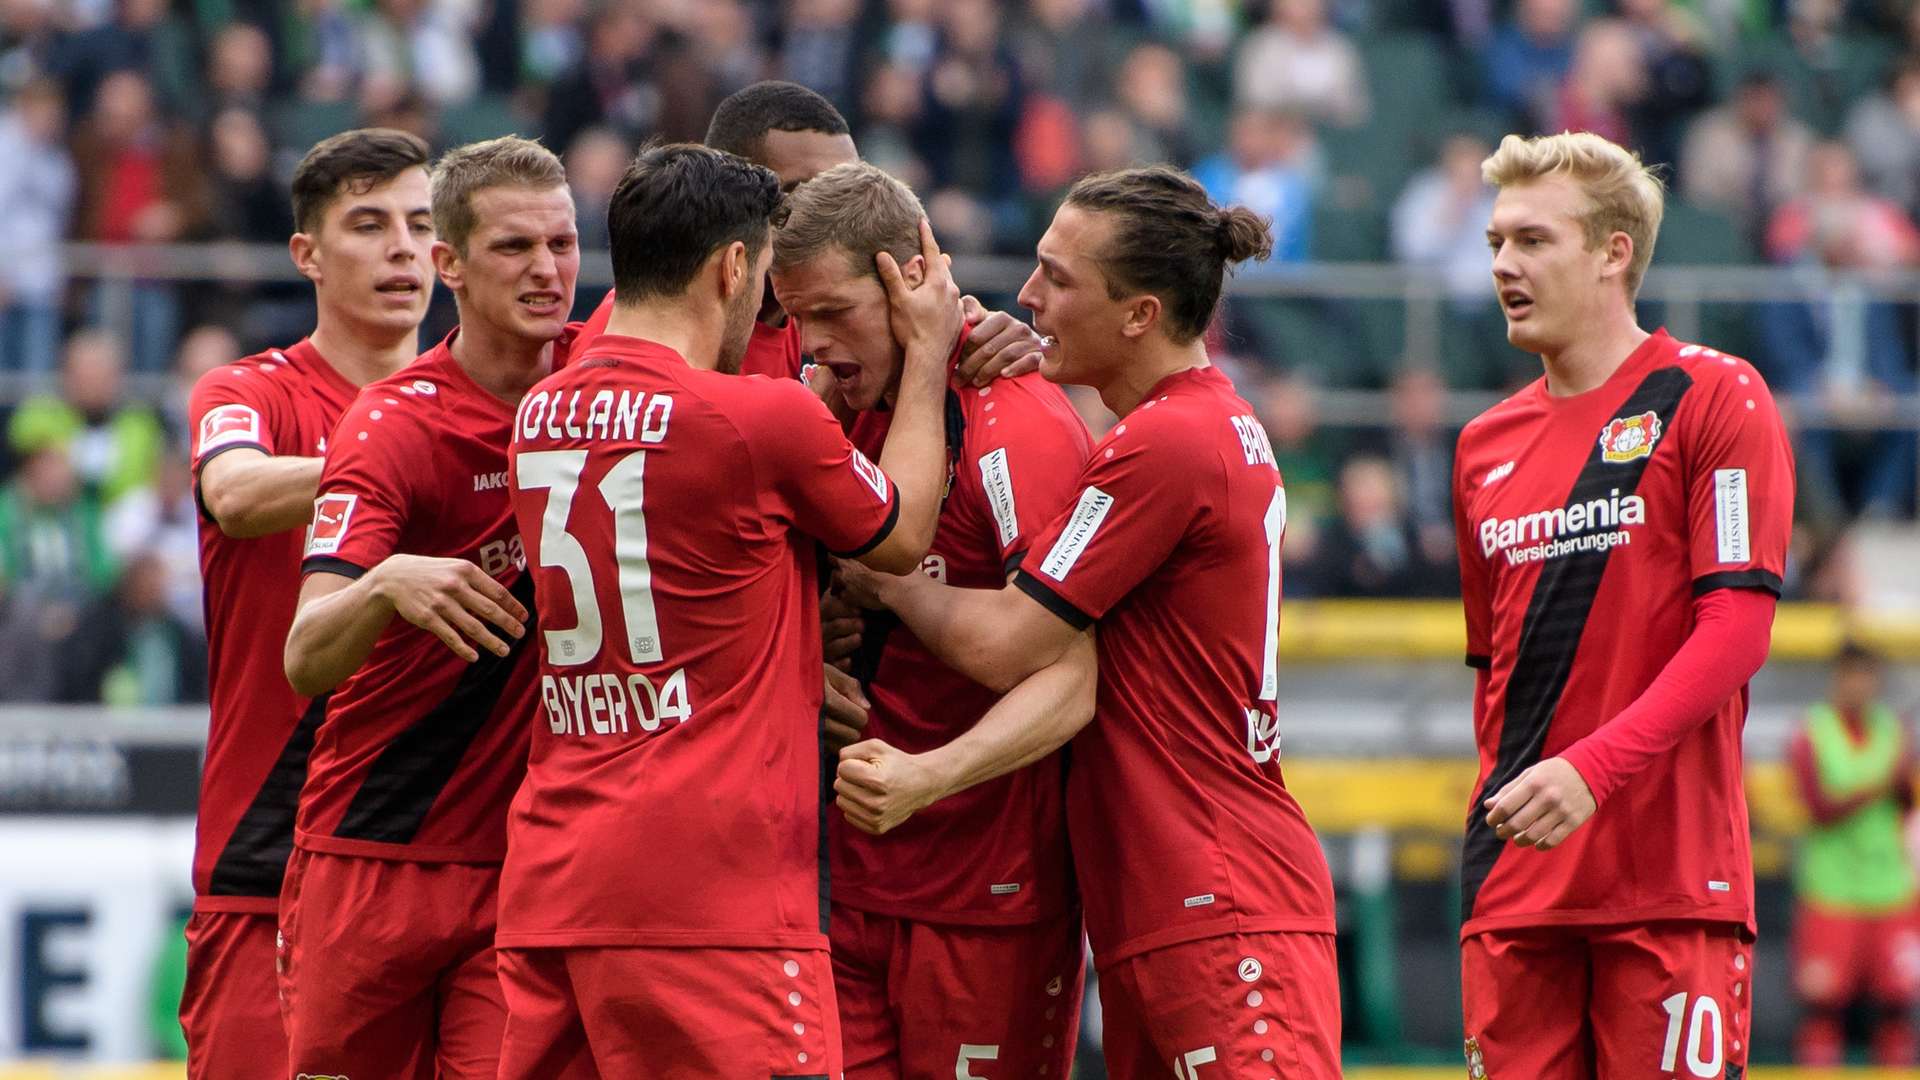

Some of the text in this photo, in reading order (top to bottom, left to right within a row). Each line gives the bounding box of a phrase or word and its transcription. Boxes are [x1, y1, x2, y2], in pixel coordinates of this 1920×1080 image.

[990, 451, 1014, 541] WESTMINSTER
[1050, 495, 1109, 576] WESTMINSTER
[1480, 488, 1646, 559] Barmenia
[1729, 470, 1741, 560] WESTMINSTER
[480, 534, 527, 577] Ba
[516, 449, 664, 667] 31
[1505, 530, 1631, 566] Versicherungen
[1661, 992, 1723, 1079] 10
